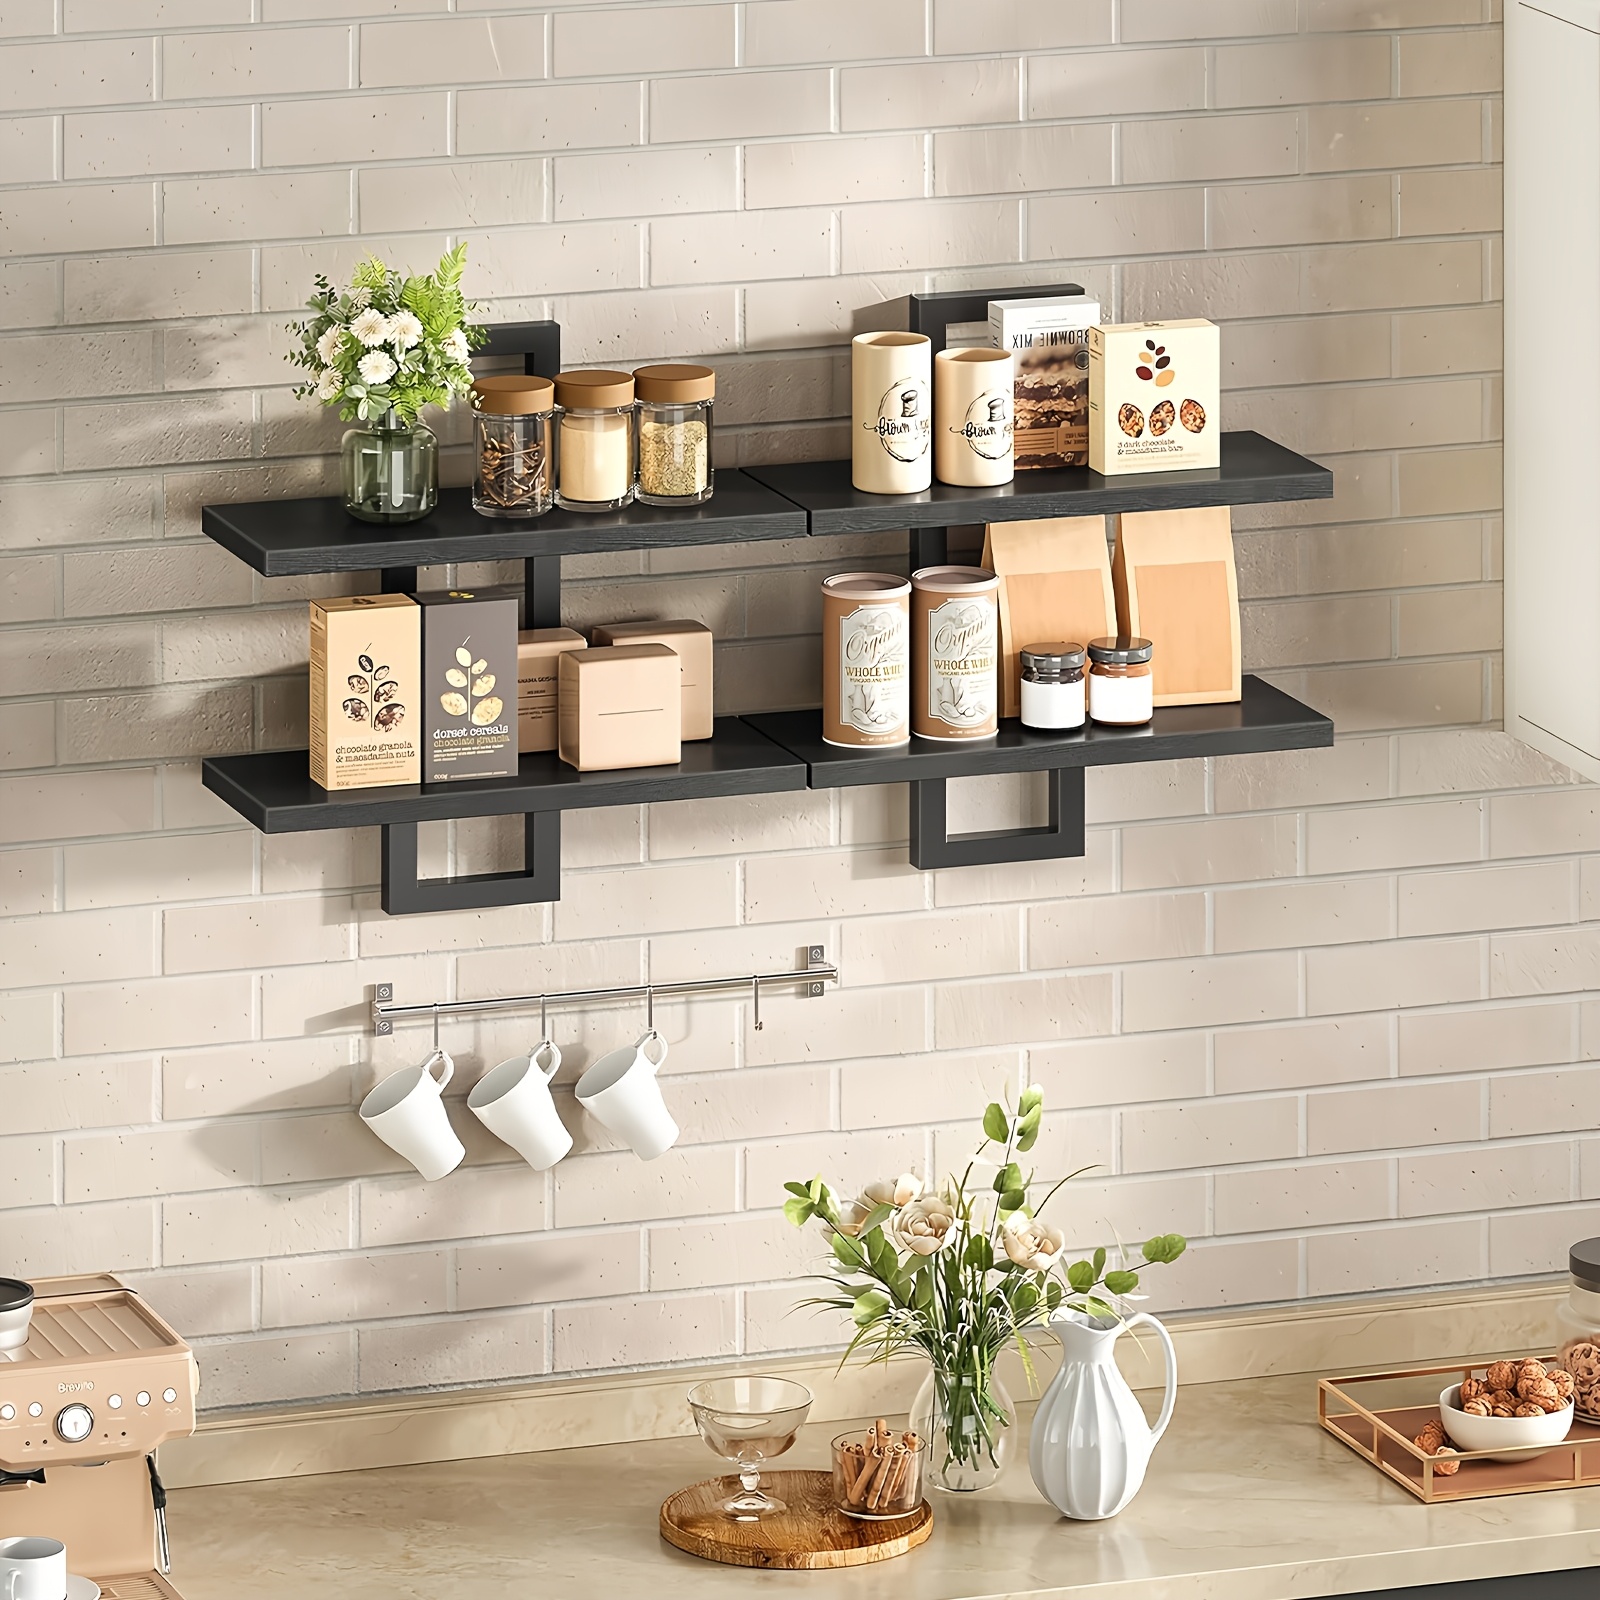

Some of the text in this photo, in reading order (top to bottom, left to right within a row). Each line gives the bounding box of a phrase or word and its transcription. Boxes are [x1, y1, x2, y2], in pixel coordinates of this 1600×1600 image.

[934, 608, 990, 658] Organi
[934, 659, 970, 671] WHOLE
[845, 666, 882, 677] WHOLE
[433, 724, 509, 739] dorset cereals
[335, 755, 344, 763] &
